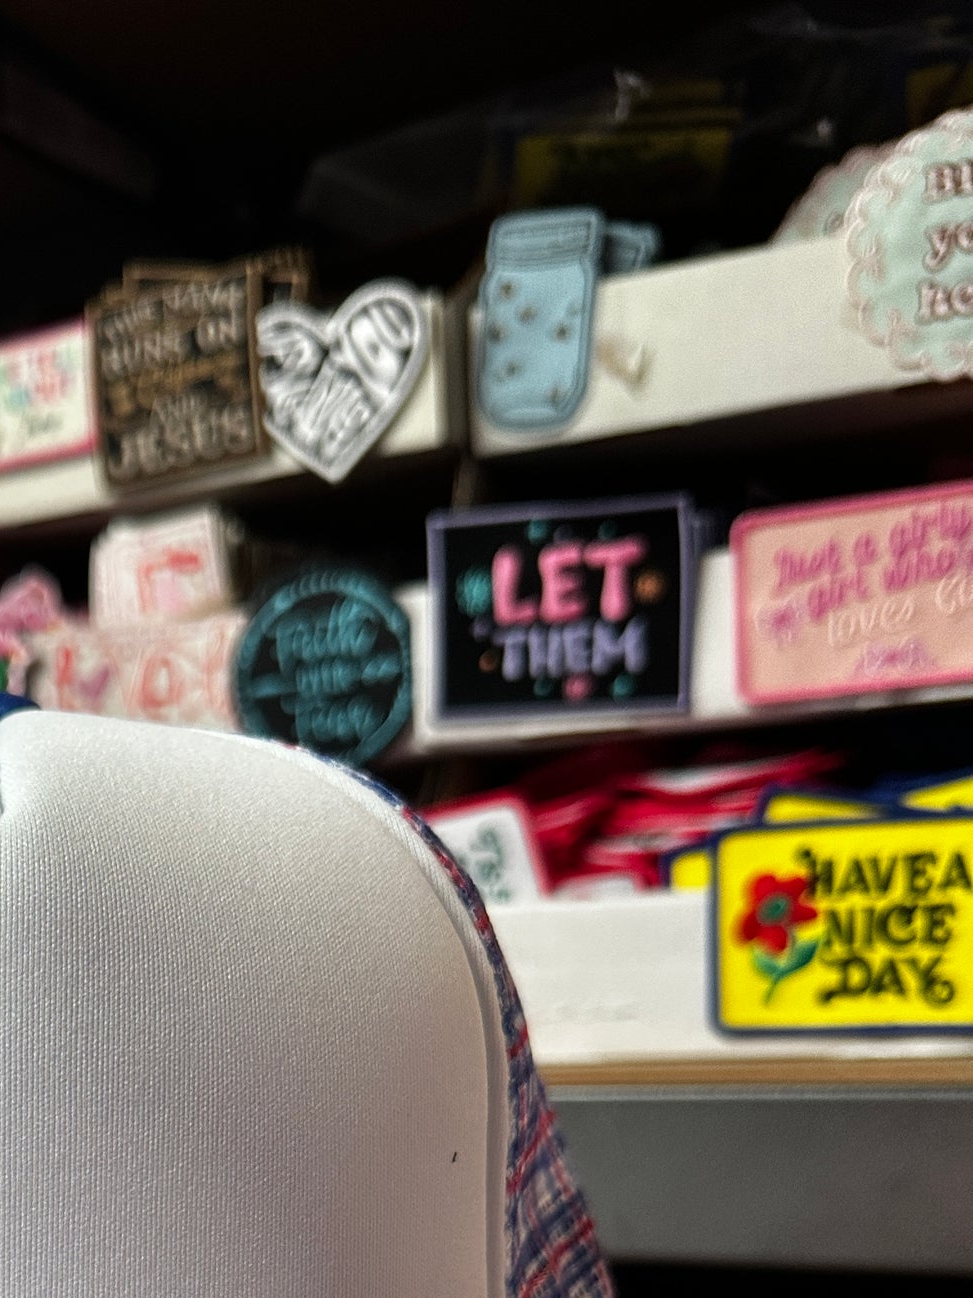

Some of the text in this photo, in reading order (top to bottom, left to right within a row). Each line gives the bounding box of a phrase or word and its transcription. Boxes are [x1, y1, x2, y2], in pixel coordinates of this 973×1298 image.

[490, 536, 648, 624] LET
[491, 614, 648, 683] THEM
[796, 847, 973, 898] HAVE A
[824, 903, 957, 952] NICE
[817, 954, 956, 1006] DAY
